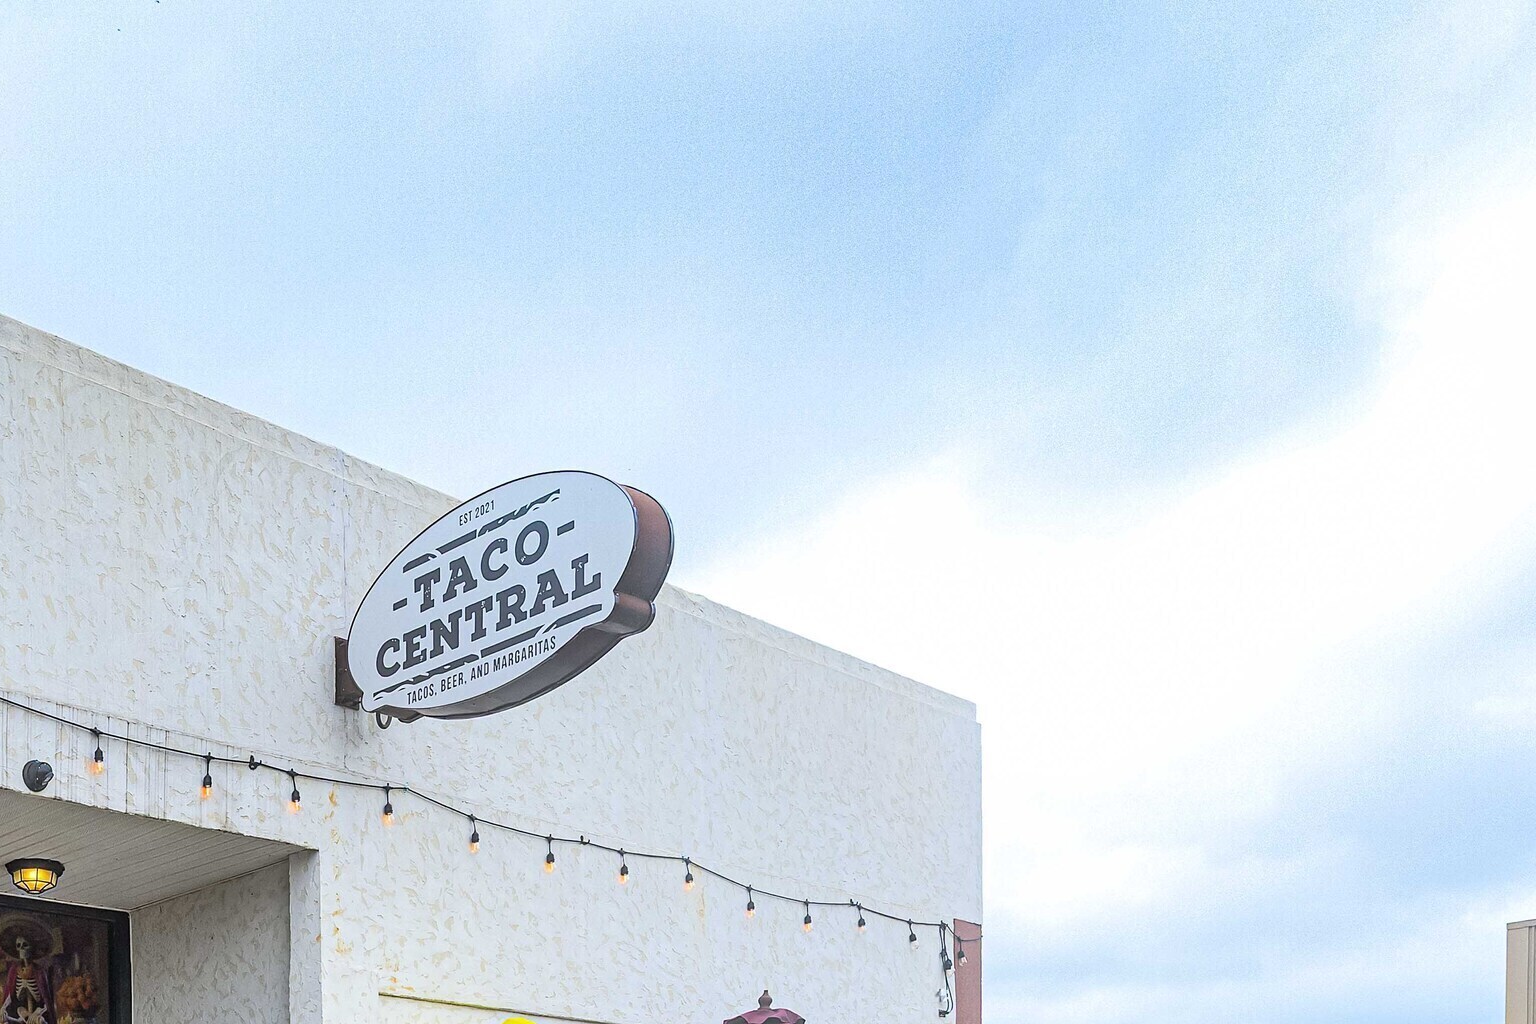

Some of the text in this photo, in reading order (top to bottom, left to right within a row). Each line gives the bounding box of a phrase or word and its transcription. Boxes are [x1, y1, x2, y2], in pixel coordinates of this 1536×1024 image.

[459, 500, 495, 526] EST 2021
[414, 520, 550, 613] TACO
[376, 553, 602, 678] CENTRAL
[407, 636, 557, 705] TACOS, BEER, AND MARGARITAS
